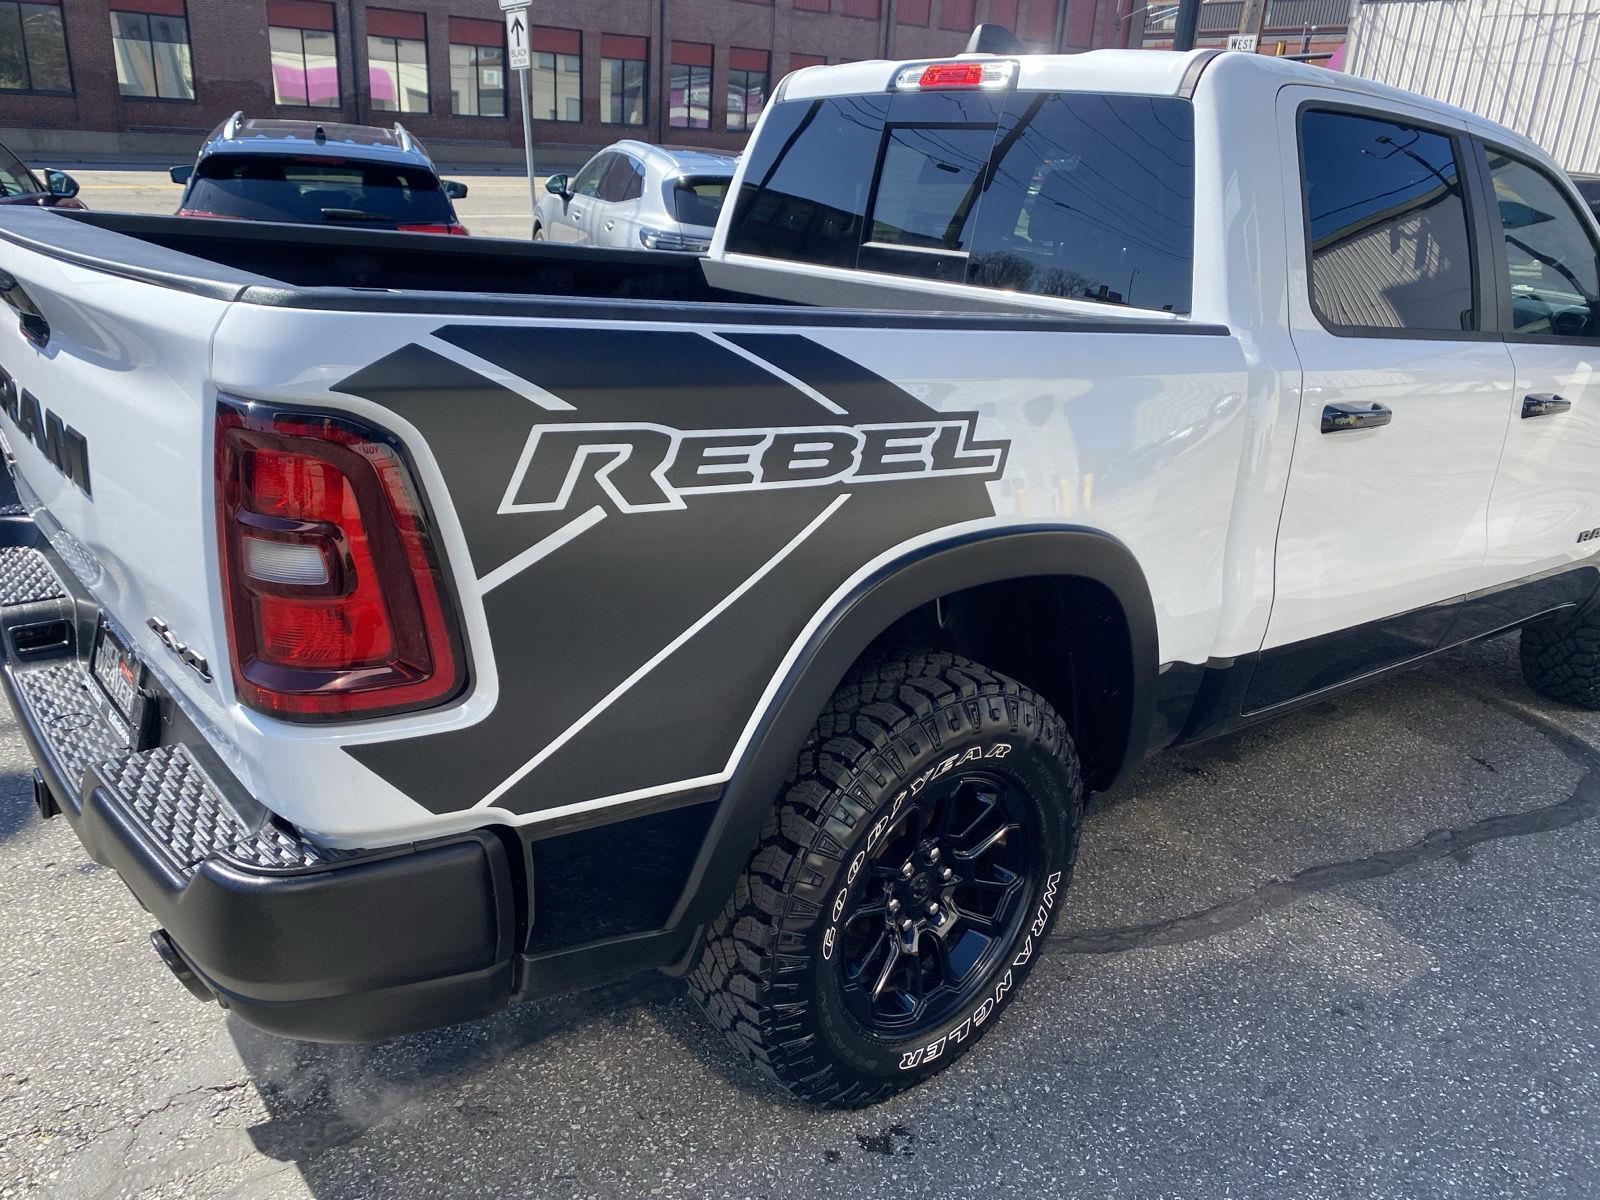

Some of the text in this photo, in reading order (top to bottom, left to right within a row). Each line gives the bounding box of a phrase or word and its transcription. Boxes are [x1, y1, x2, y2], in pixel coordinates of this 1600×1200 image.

[1231, 38, 1253, 50] WEST
[497, 418, 1003, 514] REBEL
[822, 743, 1012, 960] GOODYEAR
[899, 871, 1061, 1070] WRANGLER
